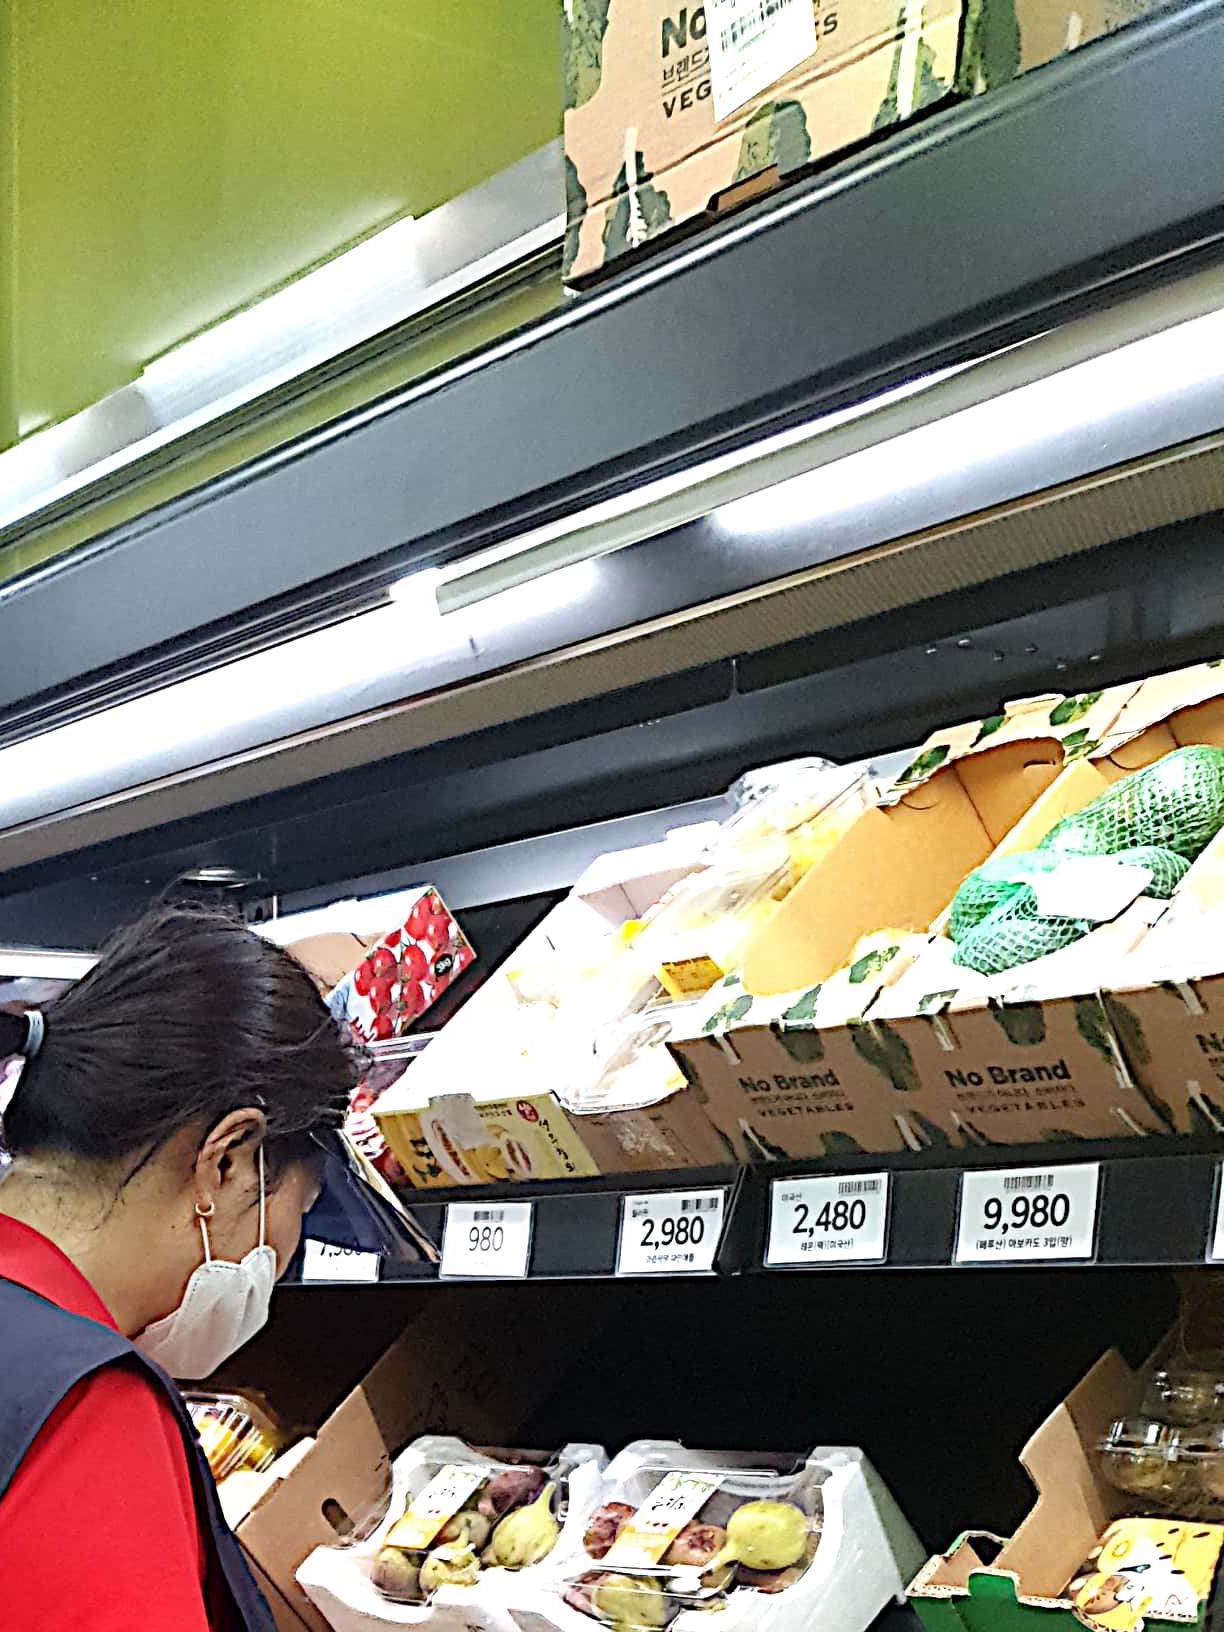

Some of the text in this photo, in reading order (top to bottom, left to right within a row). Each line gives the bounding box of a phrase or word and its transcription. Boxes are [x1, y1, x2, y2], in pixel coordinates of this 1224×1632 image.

[738, 1068, 841, 1094] No Brand
[944, 1059, 1073, 1088] No Brand
[792, 1199, 866, 1238] 2,480
[983, 1193, 1071, 1235] 9,980
[469, 1226, 505, 1252] 980
[640, 1215, 705, 1251] 2,980
